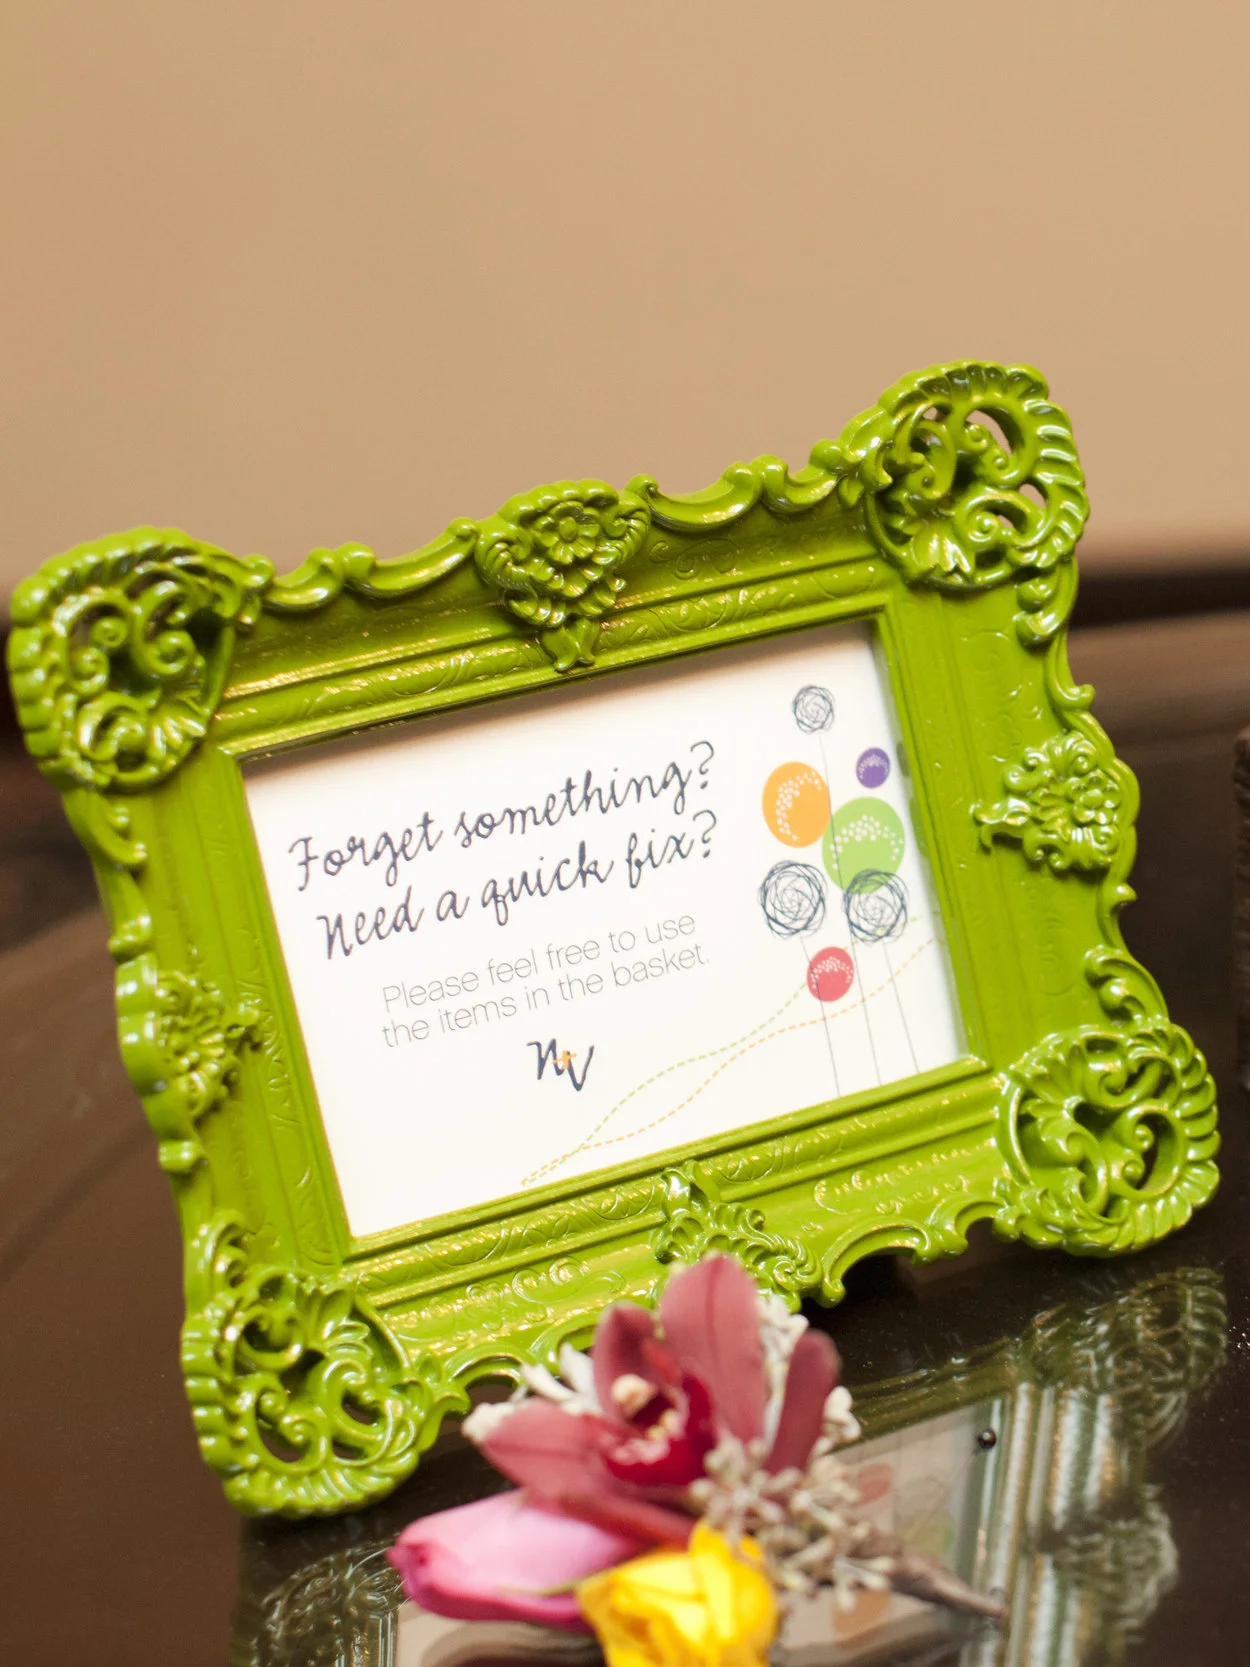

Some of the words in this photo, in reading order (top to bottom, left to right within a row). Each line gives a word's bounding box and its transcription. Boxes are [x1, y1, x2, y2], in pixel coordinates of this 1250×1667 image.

[288, 811, 443, 892] Forget
[454, 740, 715, 849] something?
[316, 885, 425, 960] Need
[436, 890, 470, 922] a
[481, 840, 614, 926] quick
[625, 809, 717, 889] fix?
[382, 971, 479, 1013] Please
[487, 948, 538, 985] feel
[546, 940, 600, 971] free
[608, 930, 636, 953] to
[645, 915, 696, 944] use
[382, 1019, 430, 1048] the
[438, 996, 517, 1034] items
[524, 985, 550, 1011] in
[558, 973, 604, 1001] the
[611, 943, 710, 988] basket.
